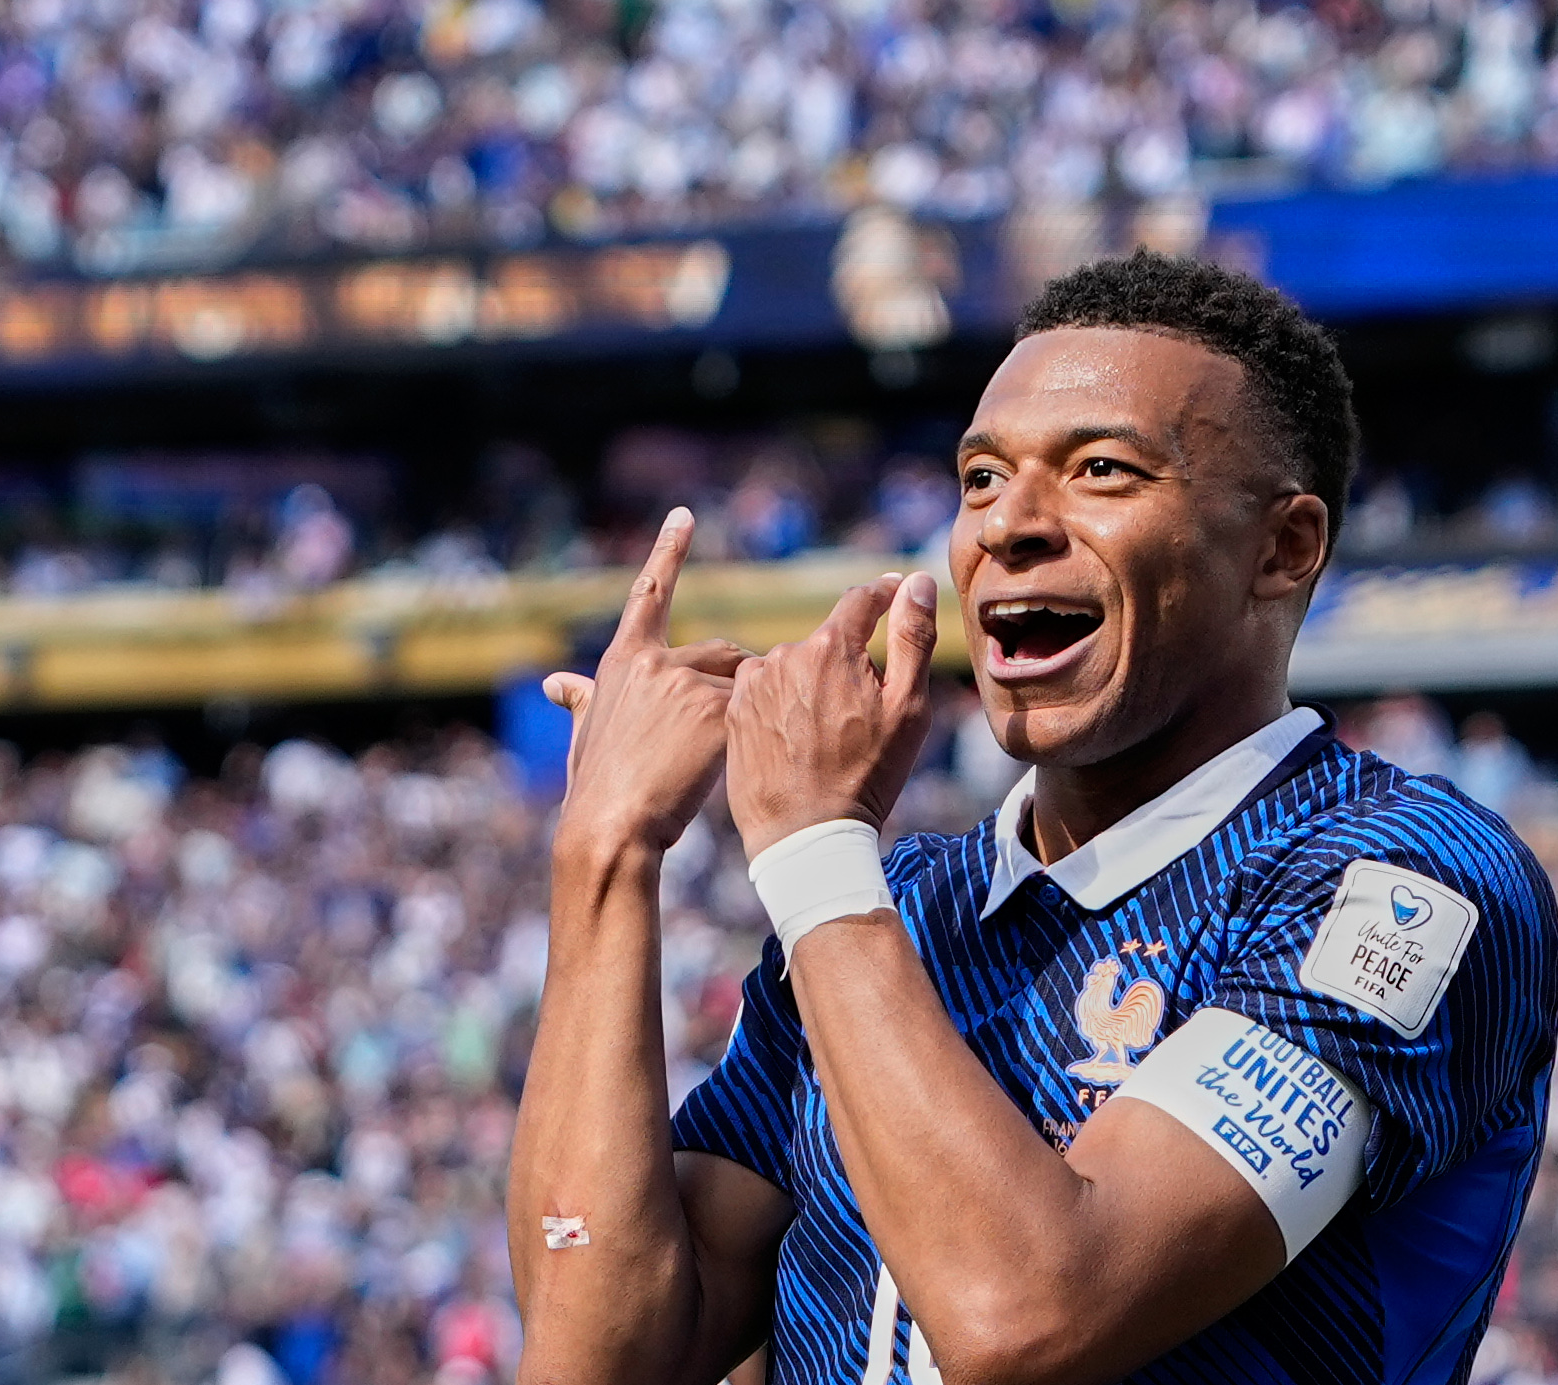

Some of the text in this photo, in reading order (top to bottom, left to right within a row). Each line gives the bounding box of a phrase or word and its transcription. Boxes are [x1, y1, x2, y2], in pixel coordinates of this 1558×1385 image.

[1350, 944, 1413, 992] PEACE
[1357, 920, 1425, 965] Unite For
[1354, 976, 1387, 1000] FIFA
[1222, 1038, 1339, 1157] UNITES
[1245, 1023, 1354, 1129] FOOTBALL
[1042, 1118, 1082, 1137] FRAN
[1195, 1064, 1324, 1190] the World
[1216, 1118, 1266, 1172] FIFA
